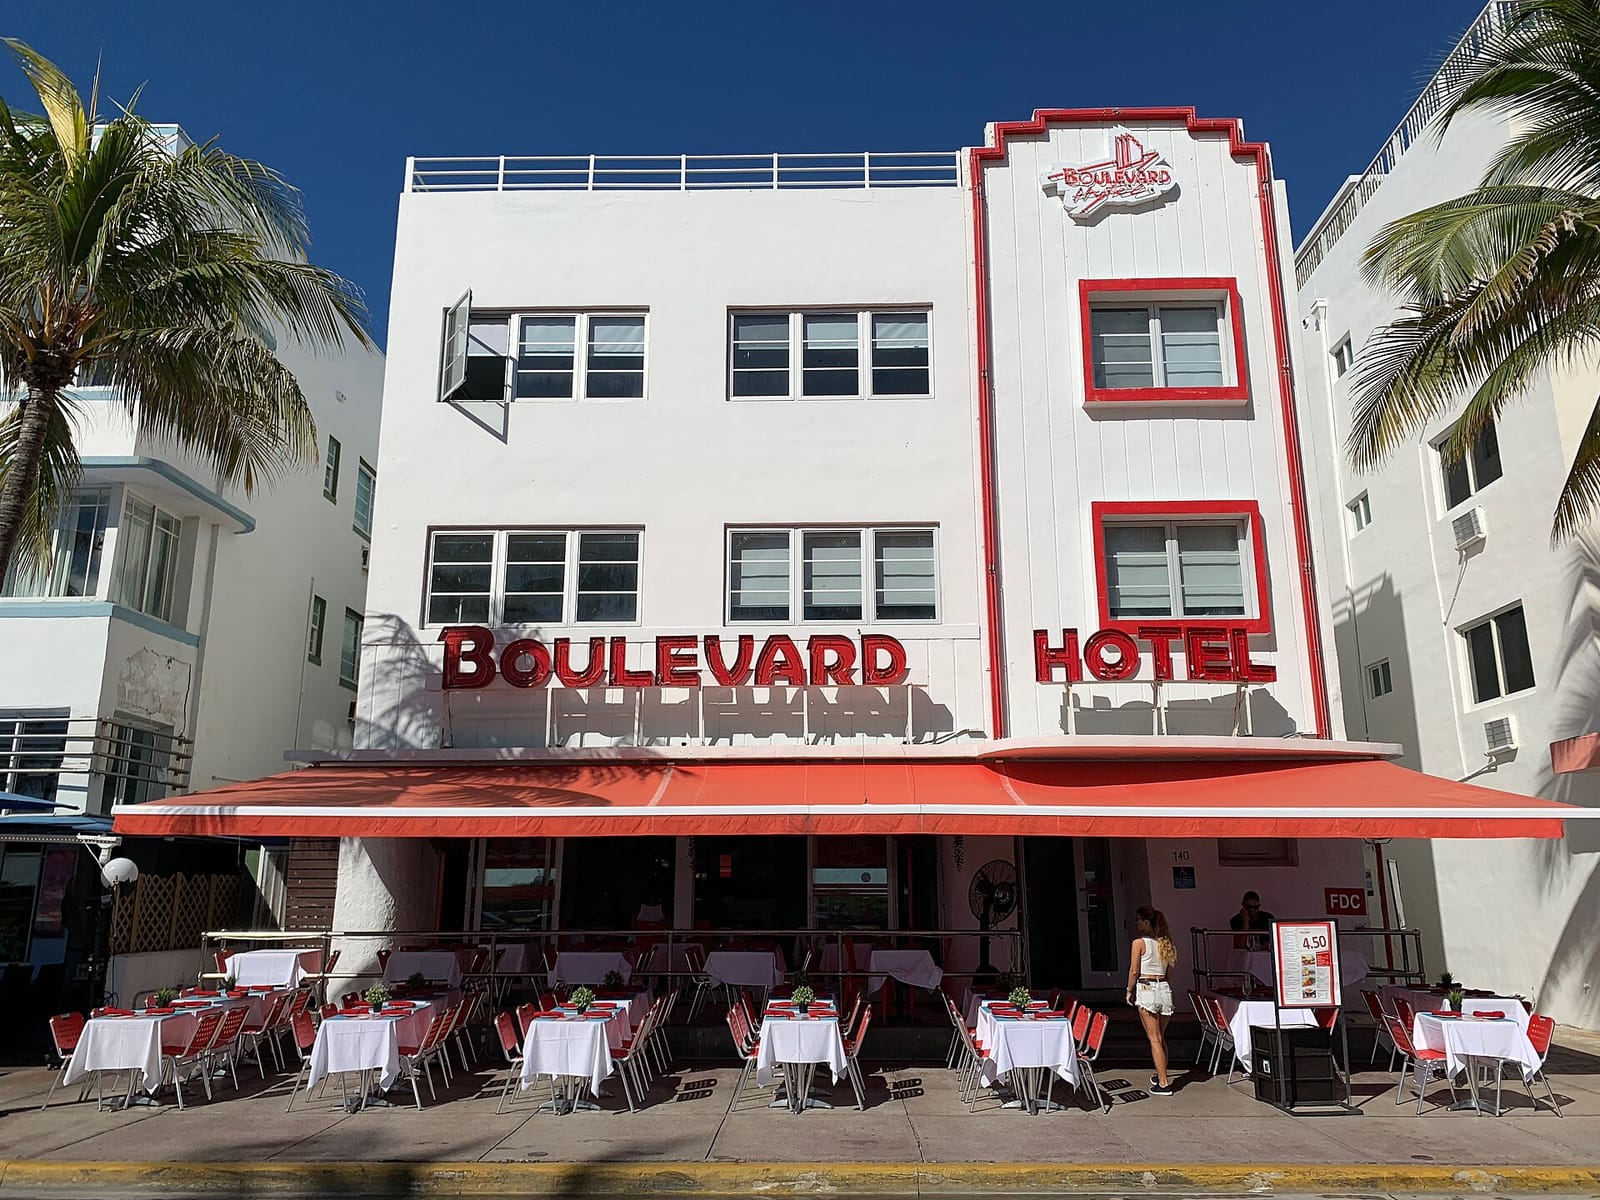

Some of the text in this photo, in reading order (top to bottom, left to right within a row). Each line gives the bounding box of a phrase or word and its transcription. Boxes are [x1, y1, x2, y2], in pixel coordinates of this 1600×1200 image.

[1063, 167, 1171, 187] BOULEVARD
[438, 625, 908, 690] BOULEVARD
[1033, 626, 1277, 683] HOTEL
[1172, 850, 1190, 862] 140
[1329, 893, 1361, 909] FDC
[1303, 935, 1327, 950] 4.50
